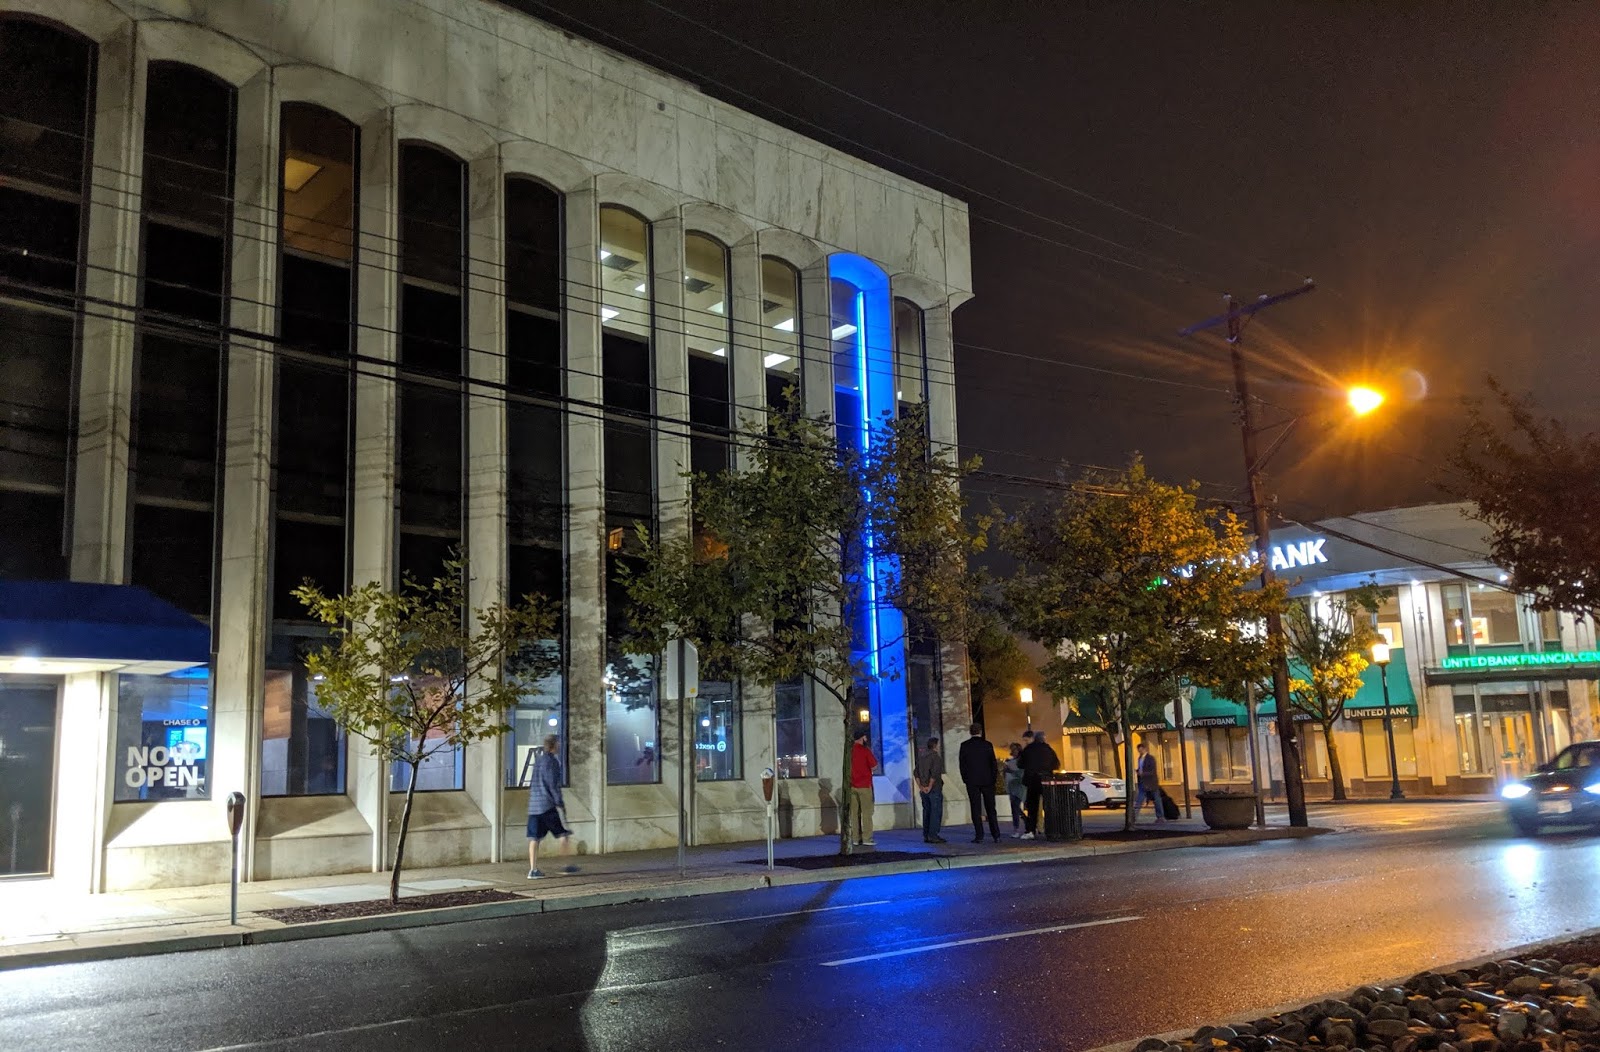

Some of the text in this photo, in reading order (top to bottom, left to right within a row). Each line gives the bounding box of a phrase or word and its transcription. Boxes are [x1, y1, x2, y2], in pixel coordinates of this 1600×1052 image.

[1255, 538, 1328, 571] ANK
[1442, 655, 1487, 669] UNITED
[1487, 654, 1521, 666] BANK
[1521, 652, 1578, 664] FINANCIAL
[1351, 707, 1409, 717] UNITED ANK
[1192, 717, 1236, 727] UNITED BANK
[127, 746, 198, 767] NOW
[125, 766, 199, 788] OPEN
